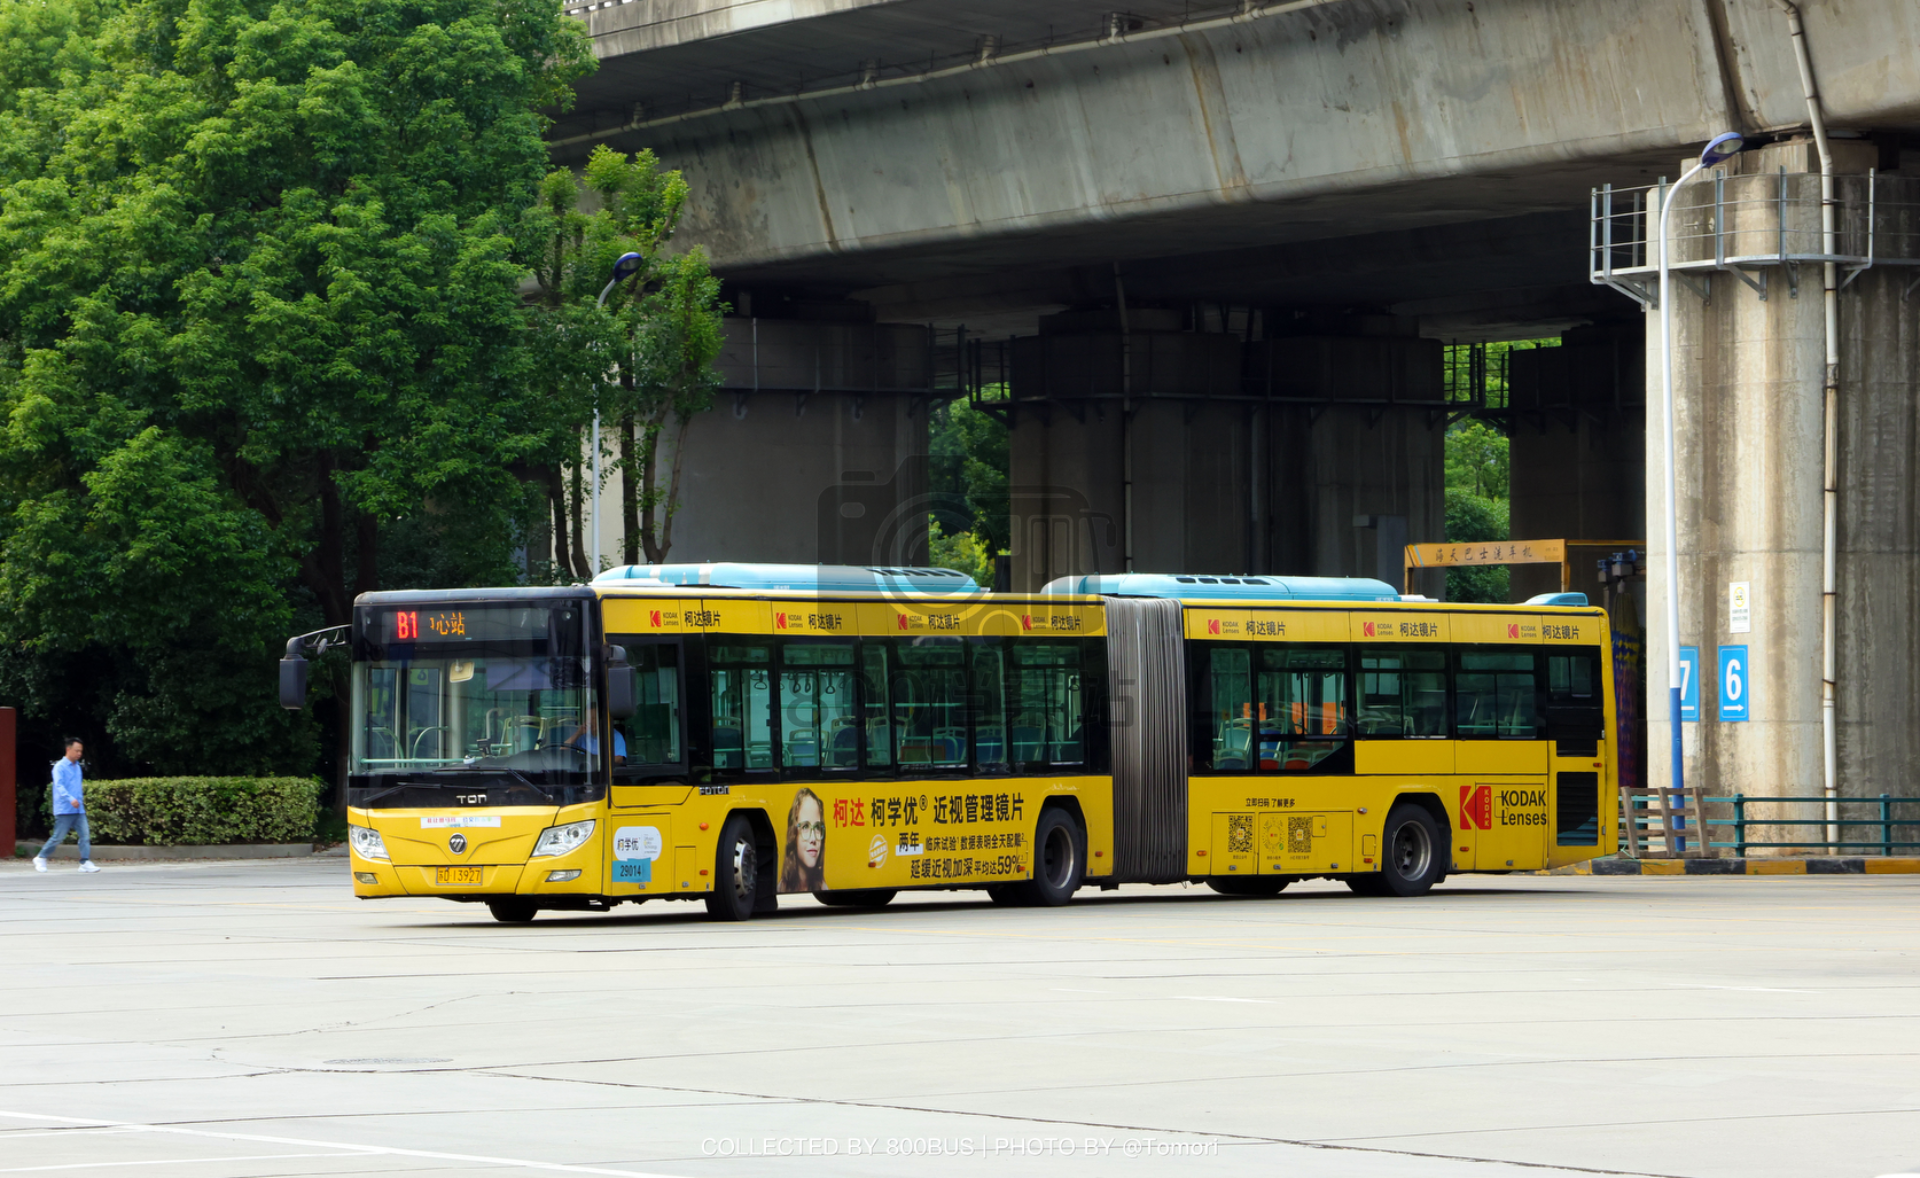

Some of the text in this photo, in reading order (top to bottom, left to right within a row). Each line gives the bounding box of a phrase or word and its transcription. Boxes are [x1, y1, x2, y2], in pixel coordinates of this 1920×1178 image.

[397, 611, 418, 639] B1
[684, 610, 721, 628] 柯达镜片
[808, 613, 842, 630] 柯达镜片
[928, 614, 960, 630] 柯达镜片
[1051, 615, 1081, 631] 柯达镜片
[1245, 620, 1286, 636] 柯达镜片
[1399, 622, 1438, 637] 柯达镜片
[1542, 625, 1580, 640] 柯达镜片
[1725, 658, 1742, 701] 6
[1245, 797, 1296, 808] 立即扫码 了解更多
[1501, 790, 1547, 807] KODAK
[833, 797, 866, 828] 柯达
[933, 792, 1025, 825] 近视管理镜片
[1501, 810, 1547, 826] Lenses
[898, 831, 920, 853] 两年
[620, 865, 642, 877] 29014
